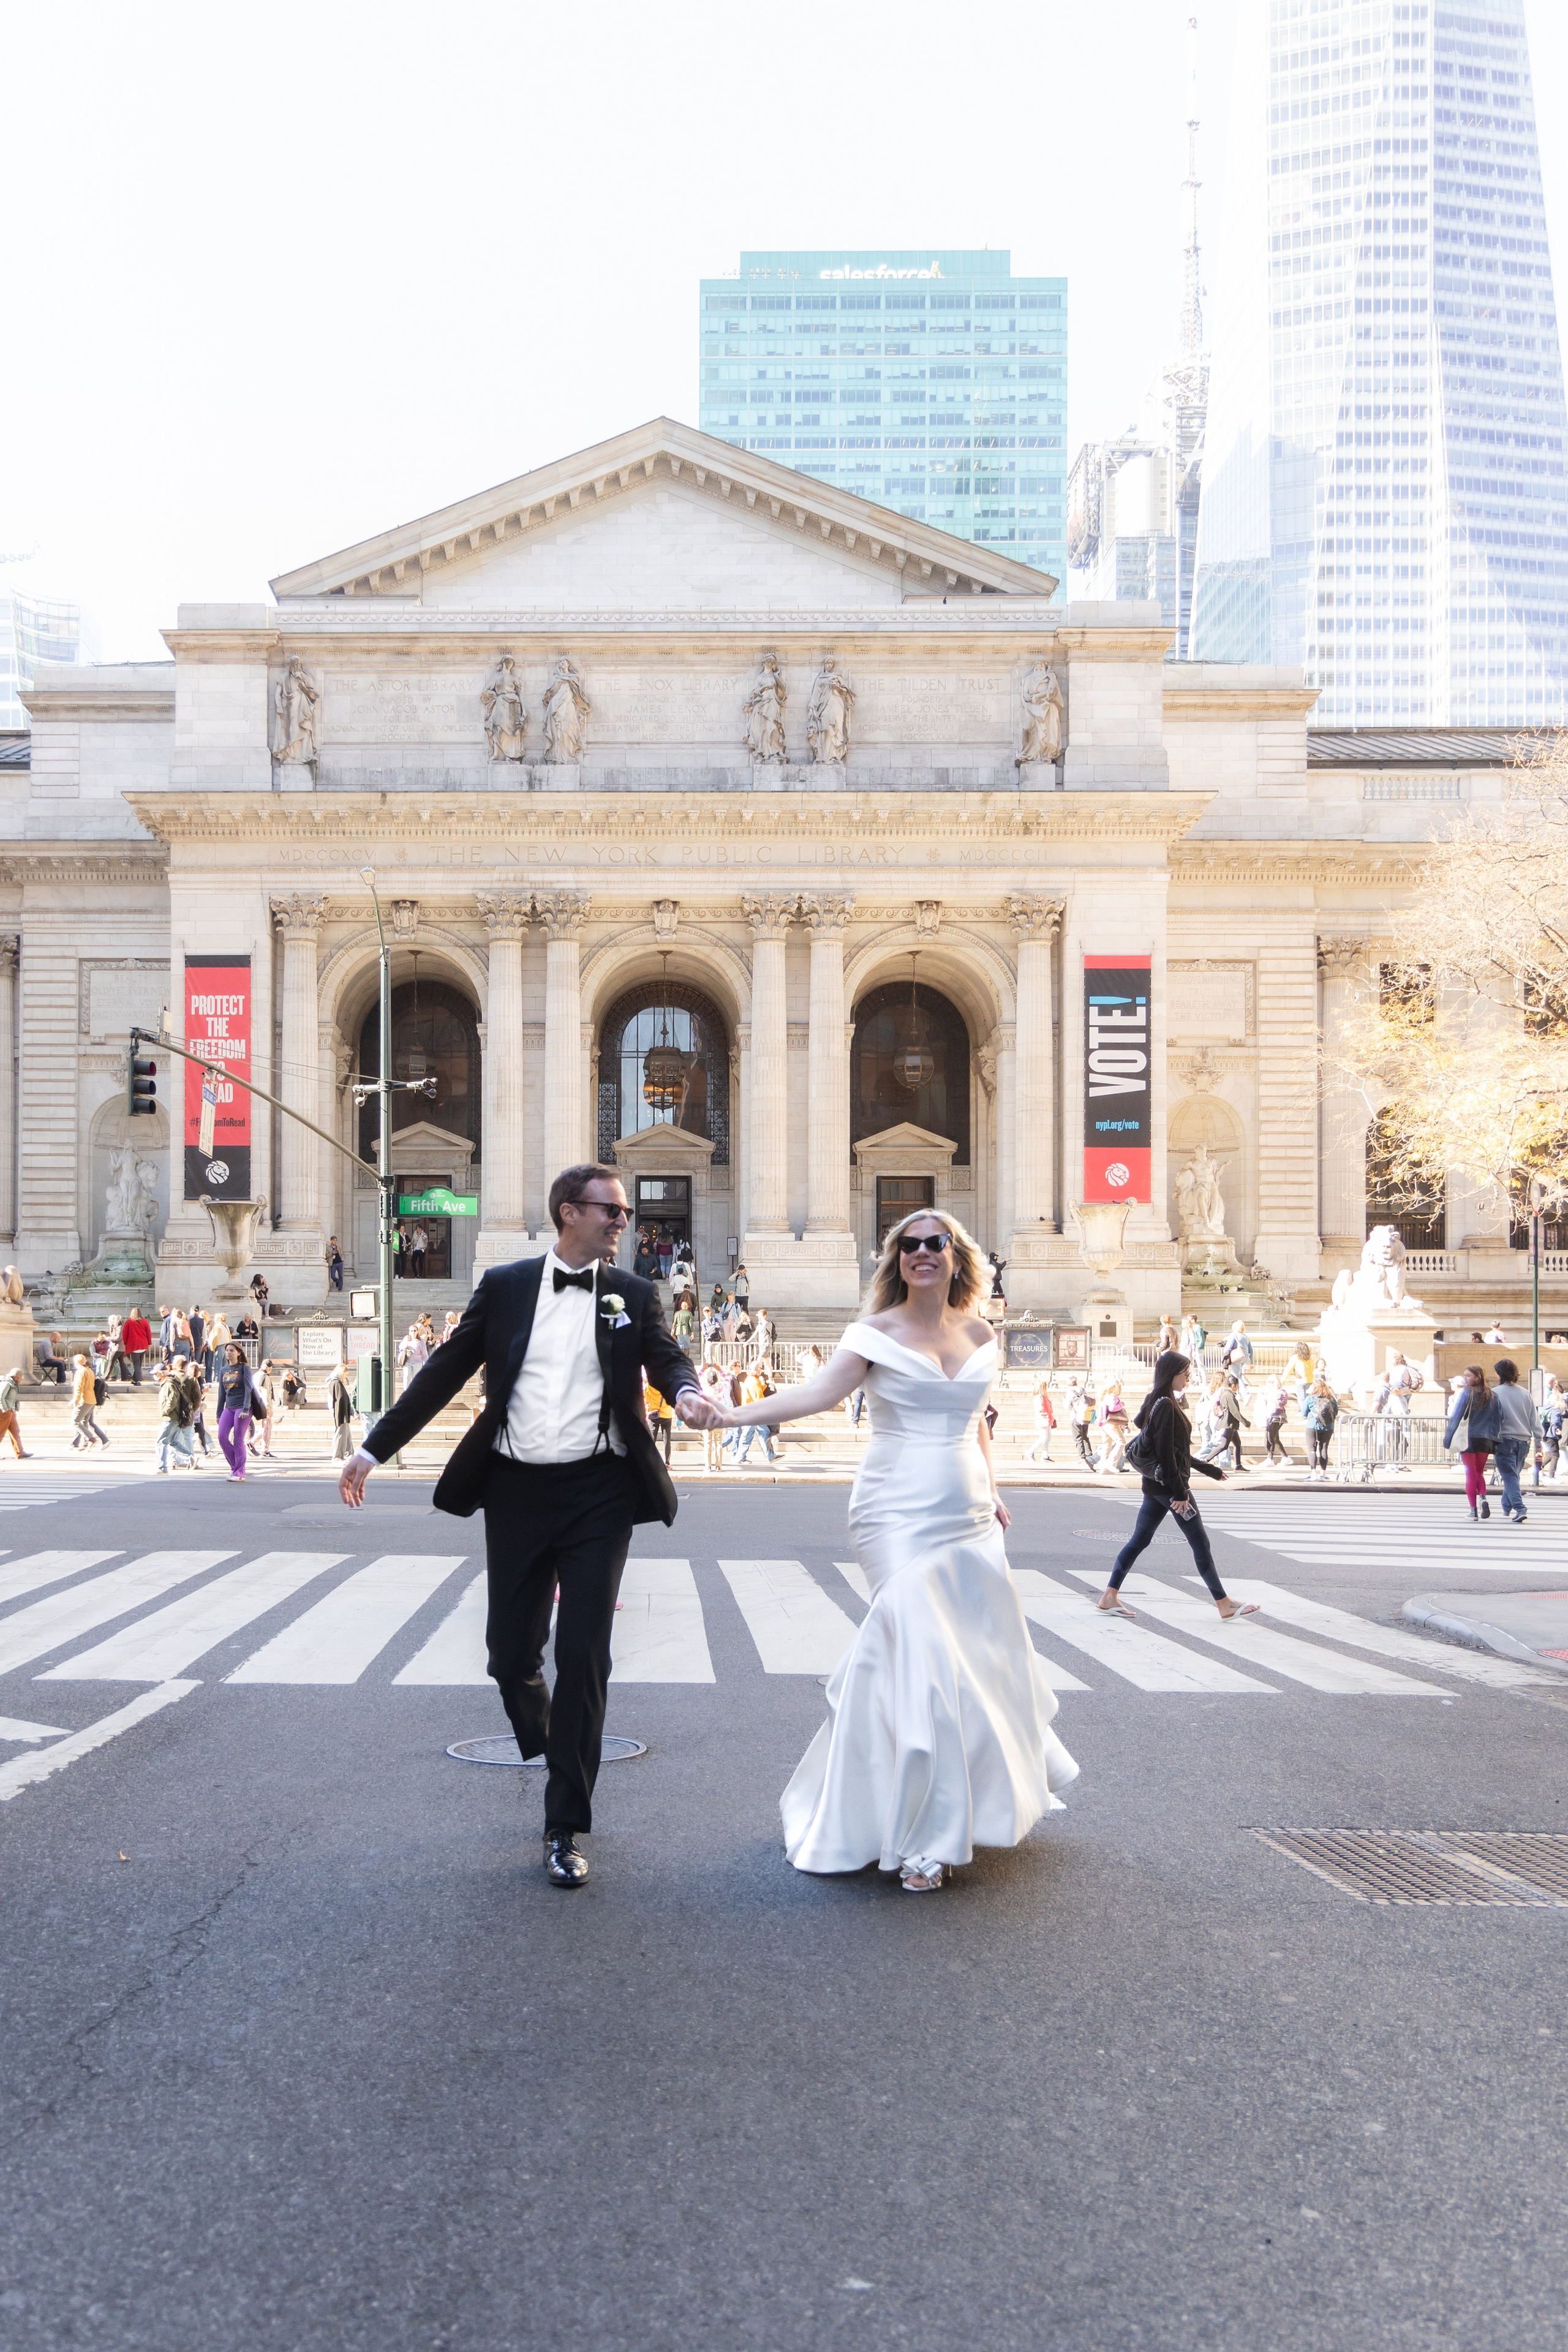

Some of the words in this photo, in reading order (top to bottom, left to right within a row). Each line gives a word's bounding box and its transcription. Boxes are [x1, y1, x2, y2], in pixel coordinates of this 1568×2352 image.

[820, 265, 930, 279] salesforce
[333, 679, 358, 691] THE
[368, 679, 410, 691] ASTOR
[418, 679, 477, 691] LIBRARY
[596, 679, 622, 691] THE
[629, 679, 674, 691] LENOX
[682, 679, 739, 691] LIBRARY
[859, 679, 886, 691] THE
[897, 679, 947, 691] TILDEN
[959, 679, 1003, 691] TRUST
[350, 706, 379, 714] JOHN
[383, 706, 417, 714] JACOB
[627, 705, 662, 714] JAMES
[671, 705, 706, 714] LENOX
[916, 704, 949, 713] JONES
[956, 704, 988, 713] TILDEN
[279, 849, 375, 861] MDCCCXCV
[431, 845, 483, 864] THE
[504, 845, 568, 864] NEW
[590, 846, 660, 864] YORK
[681, 846, 772, 864] PUBLIC
[797, 846, 907, 864] LIBRARY
[960, 849, 1048, 861] MDCCCCII
[190, 995, 245, 1016] PROTECT
[206, 1017, 230, 1038] THE
[190, 1039, 246, 1059] FREEDOM
[1088, 996, 1147, 1097] VOTE!
[190, 1117, 246, 1127] #FomToRead
[1095, 1119, 1139, 1131] nypl.org/vote
[411, 1199, 439, 1212] Fifth
[442, 1200, 466, 1212] Ave
